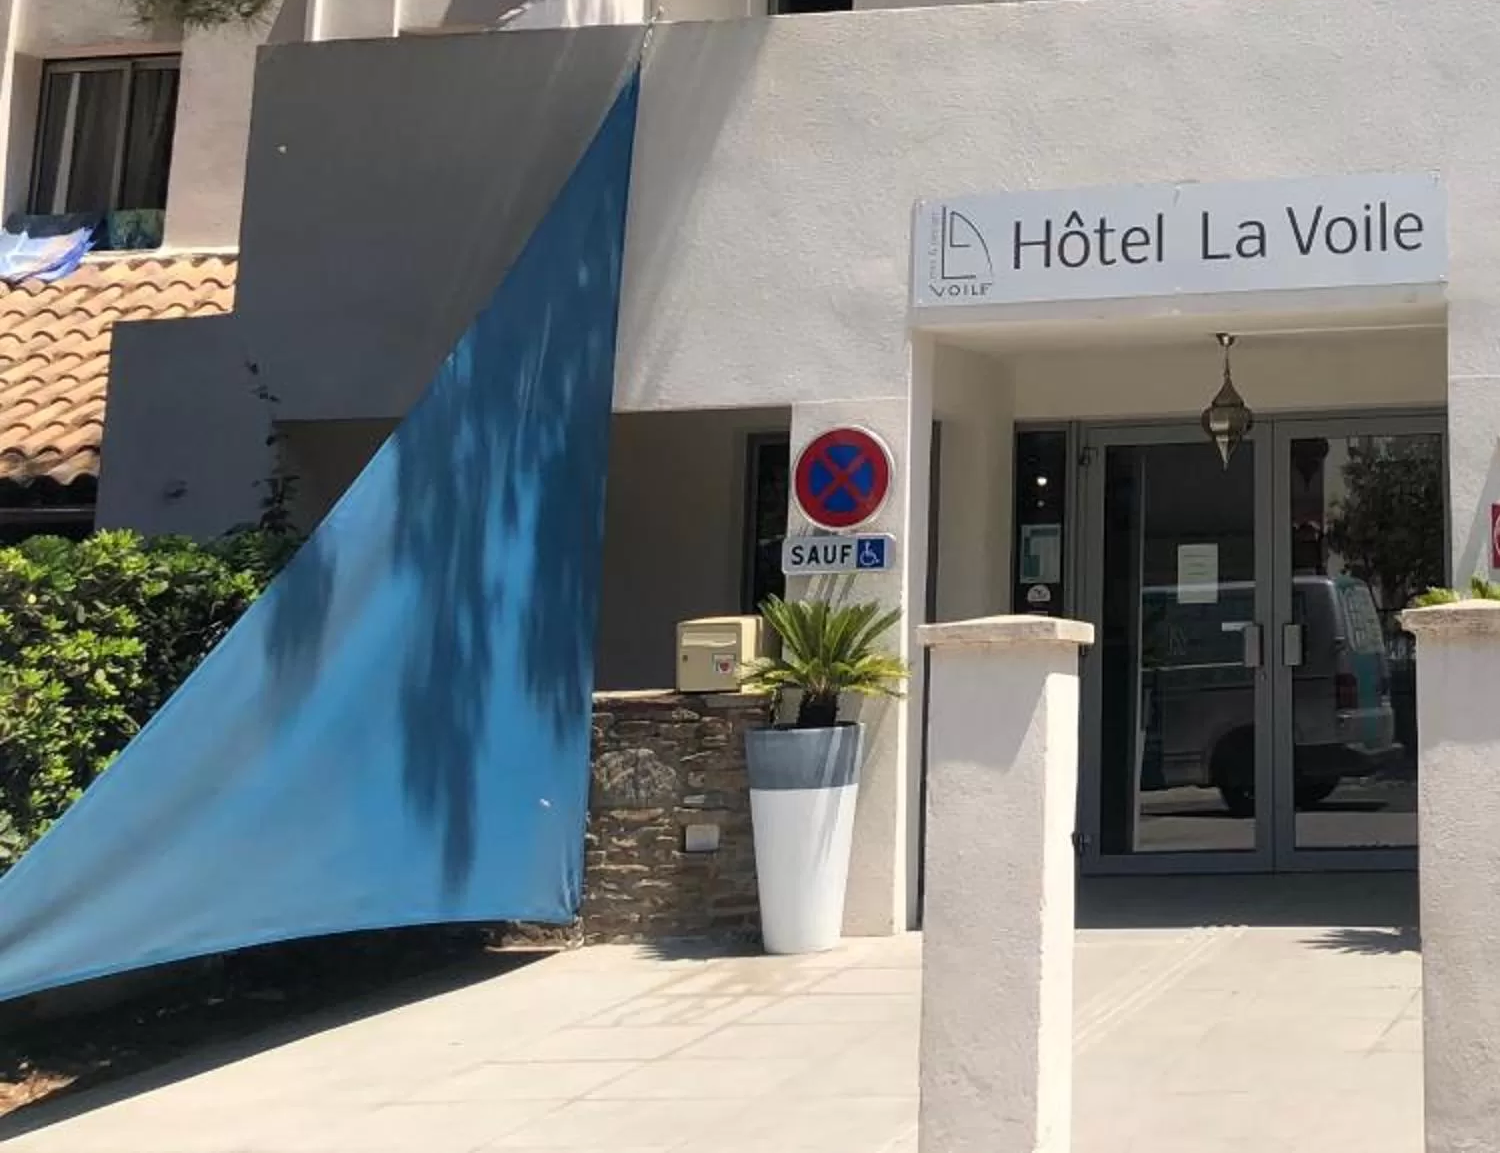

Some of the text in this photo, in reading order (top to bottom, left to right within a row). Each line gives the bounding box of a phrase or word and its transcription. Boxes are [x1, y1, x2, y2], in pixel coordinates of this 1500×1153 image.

[1013, 201, 1424, 269] Hôtel La Voile
[791, 545, 853, 566] SAUF
